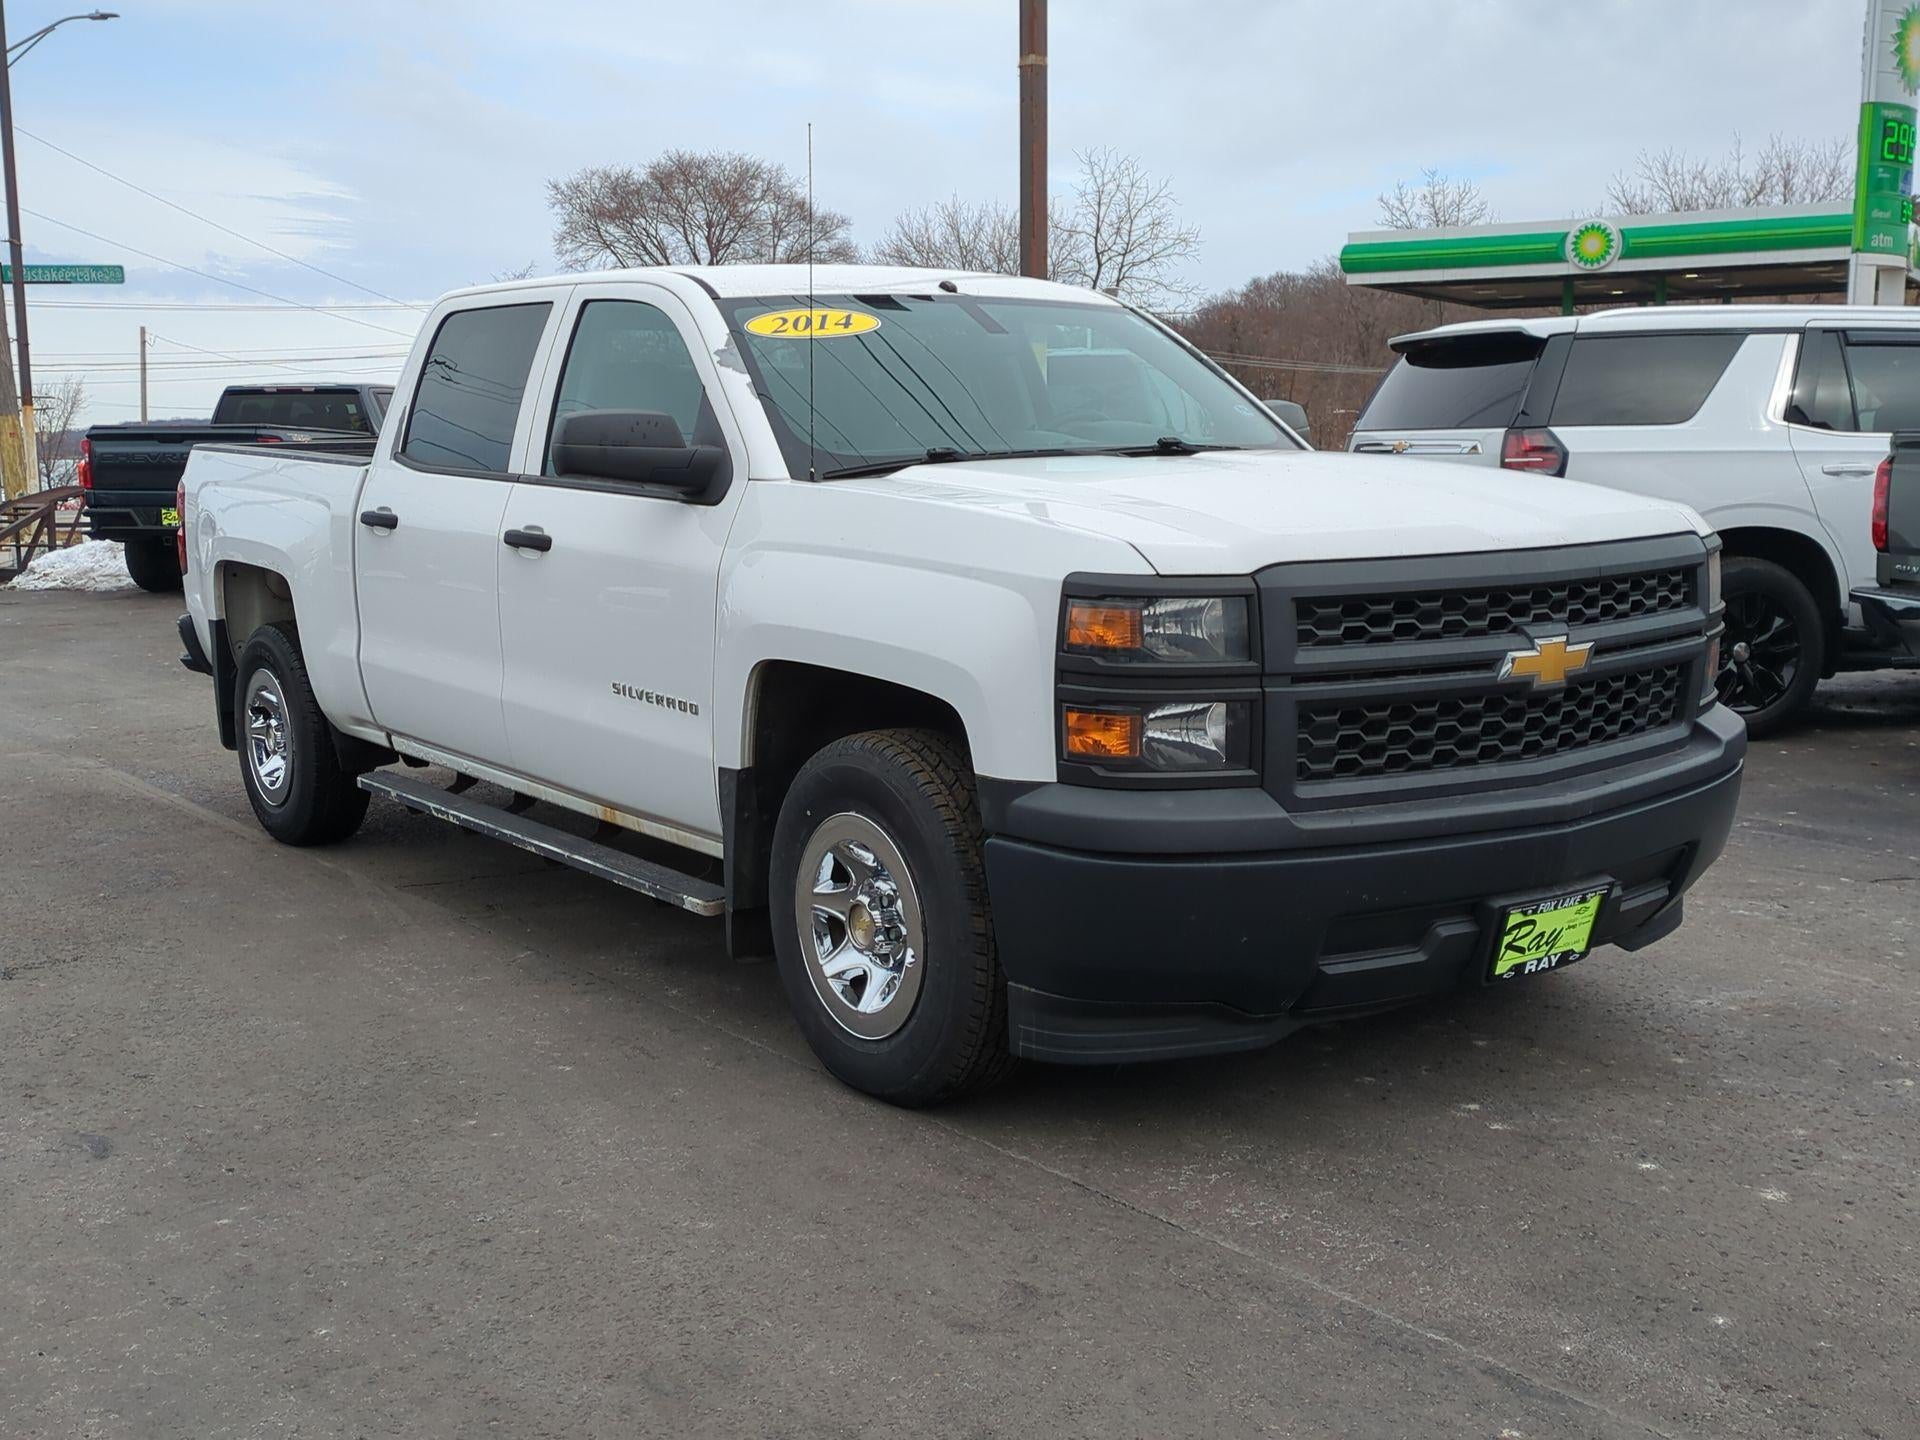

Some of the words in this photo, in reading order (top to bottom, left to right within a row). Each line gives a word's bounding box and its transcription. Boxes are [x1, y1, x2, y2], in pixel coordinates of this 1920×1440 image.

[1870, 232, 1894, 249] atm
[22, 267, 72, 281] istakee
[76, 267, 102, 281] Lake
[770, 313, 853, 334] 2014
[611, 682, 699, 716] SILVERADO
[1538, 901, 1557, 913] FOX
[1559, 895, 1582, 908] LAKE
[1499, 918, 1564, 962] Ray
[1525, 953, 1561, 974] RAY
